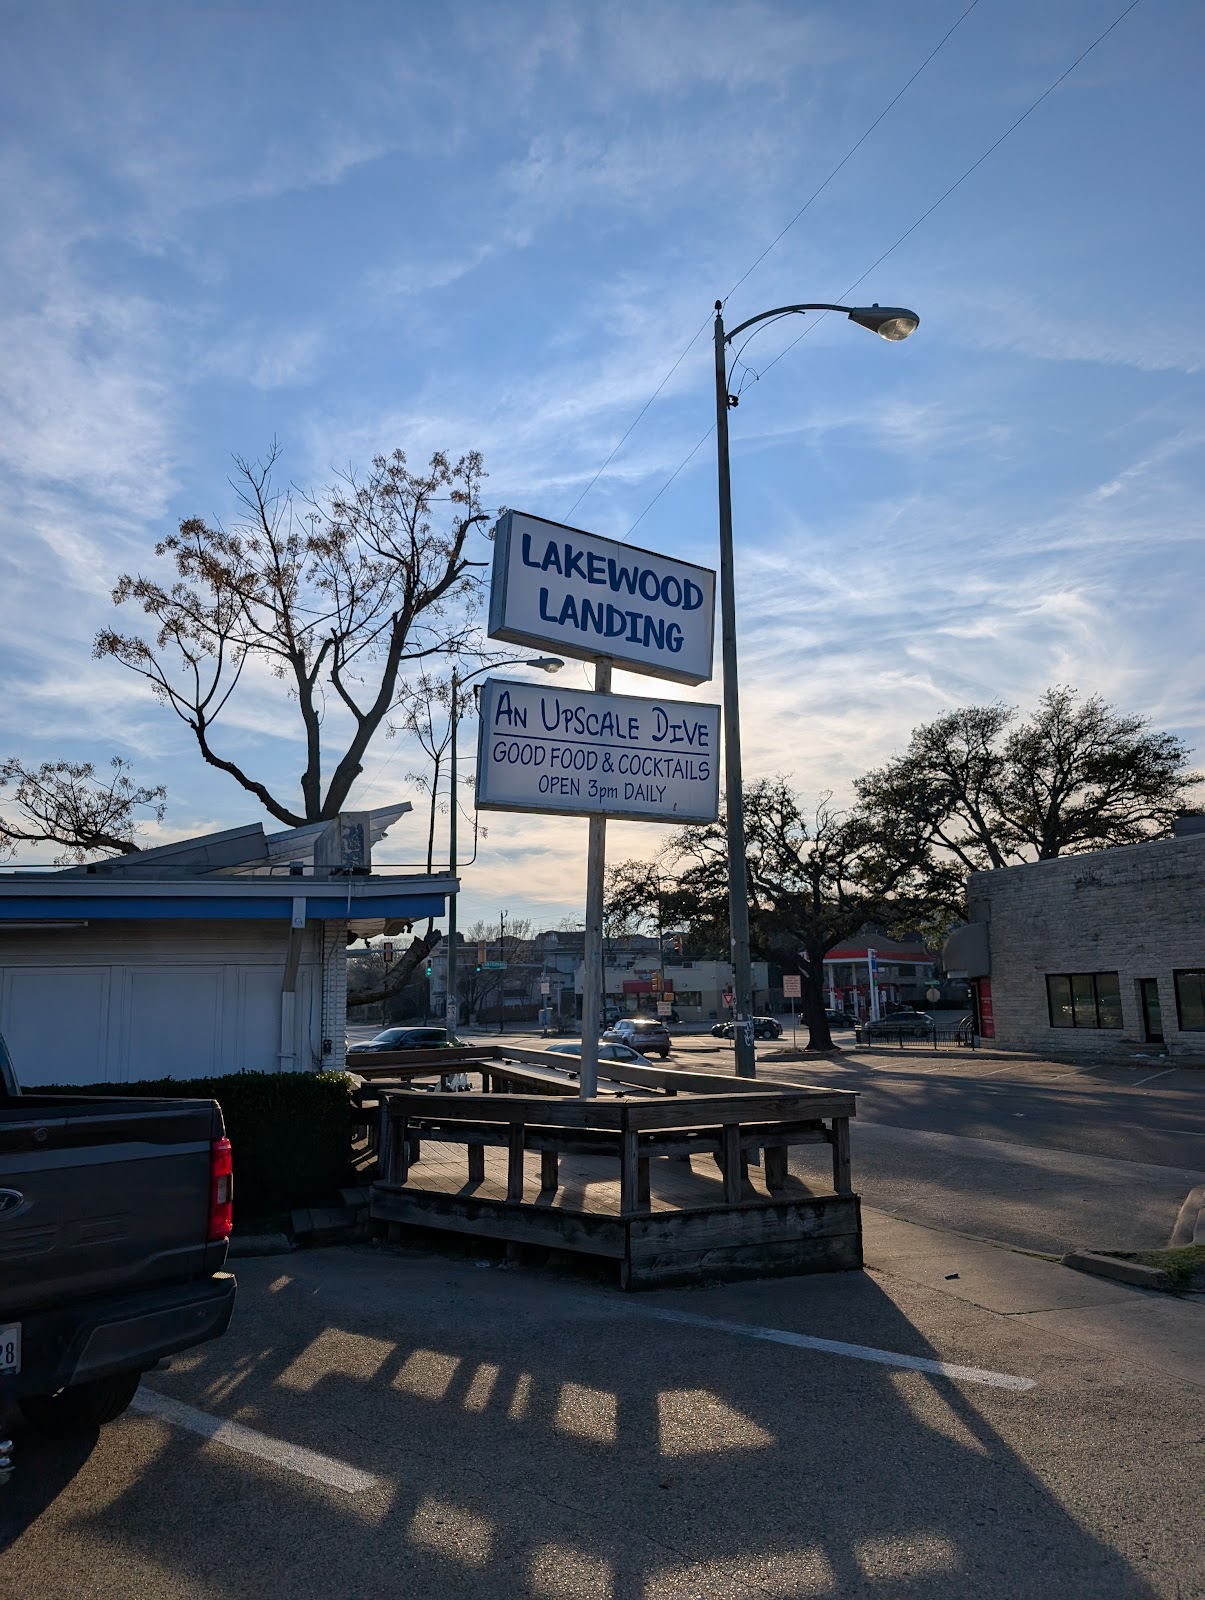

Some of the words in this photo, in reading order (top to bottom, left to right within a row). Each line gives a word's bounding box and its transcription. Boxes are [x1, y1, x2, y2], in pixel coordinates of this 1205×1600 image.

[522, 533, 703, 610] LAKEWOOD
[540, 587, 684, 653] LANDING
[493, 741, 545, 766] GOOD
[550, 747, 598, 771] FOOD
[602, 752, 615, 773] &
[618, 754, 710, 781] COCKTAILS
[538, 774, 580, 796] OPEN
[588, 779, 618, 804] 3pm
[624, 782, 667, 803] DAILY
